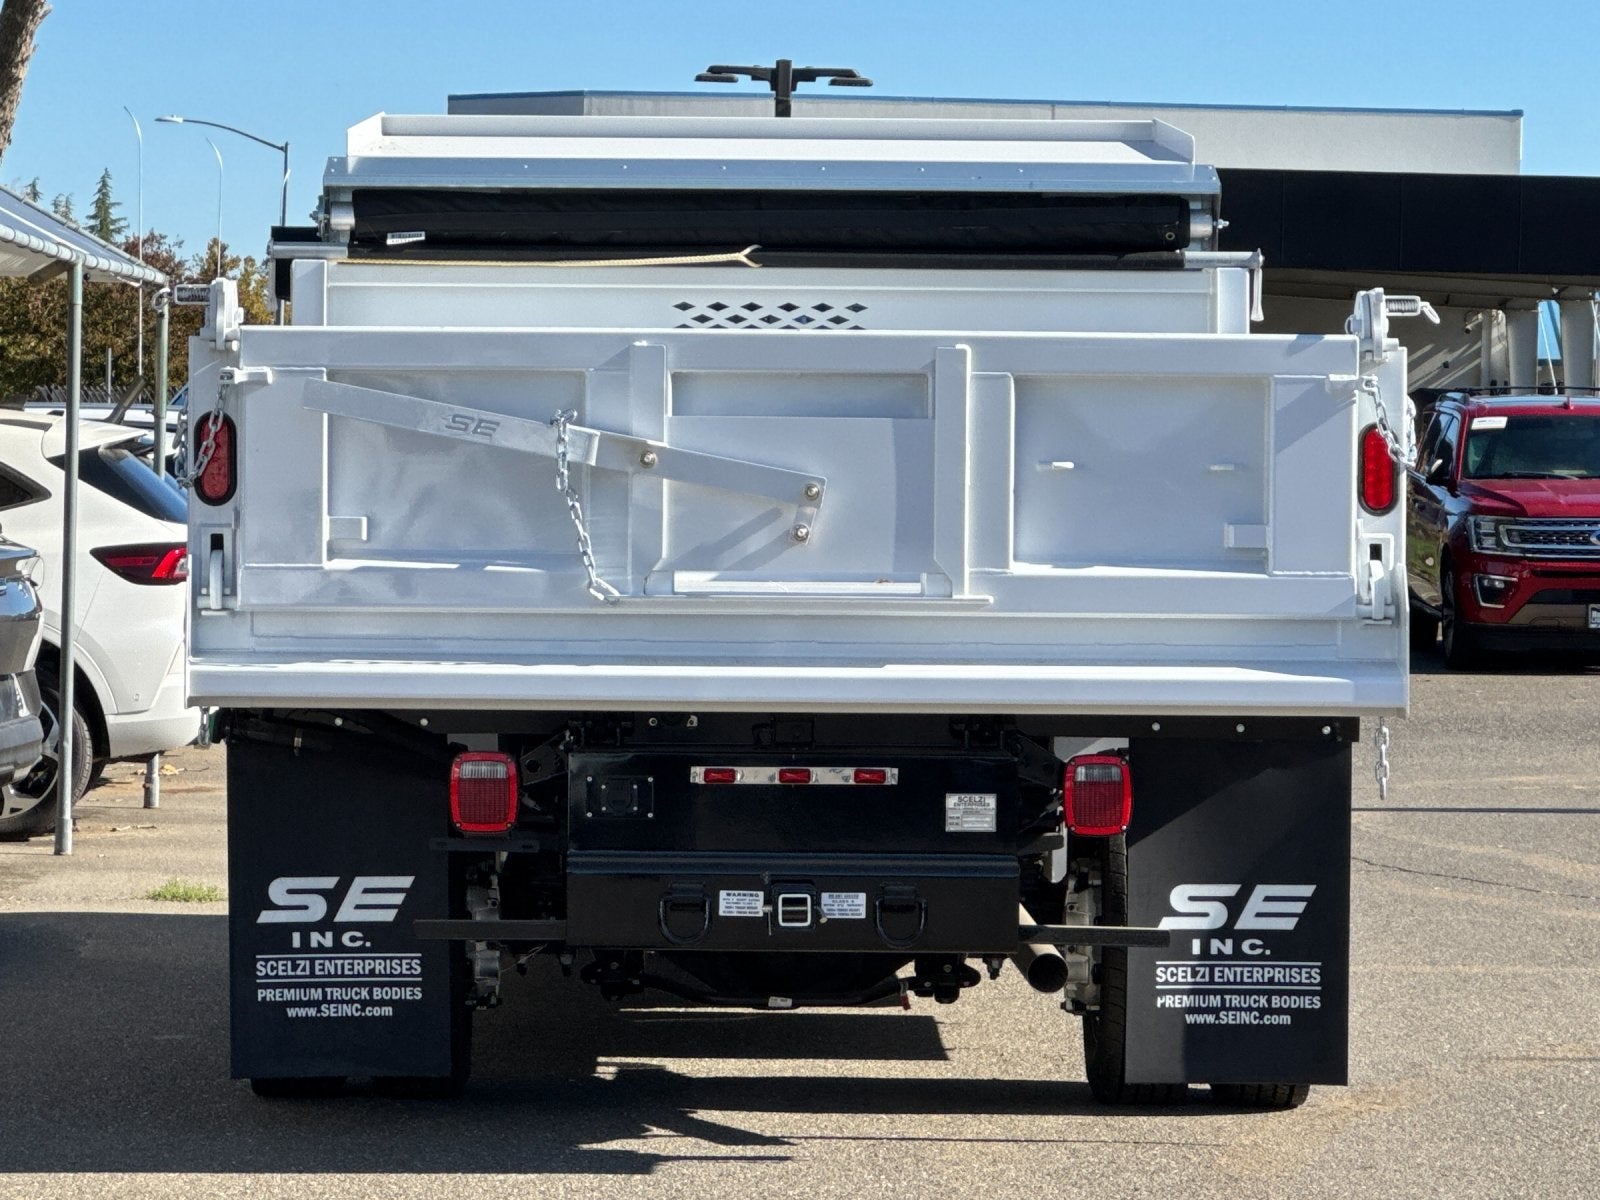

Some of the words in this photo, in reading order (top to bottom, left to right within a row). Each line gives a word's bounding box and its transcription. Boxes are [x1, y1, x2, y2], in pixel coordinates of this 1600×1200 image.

[445, 413, 500, 437] SE
[957, 795, 986, 803] SCELZI
[256, 875, 415, 924] SE
[1157, 883, 1317, 930] SE
[291, 931, 371, 948] INC.
[1191, 938, 1271, 955] INC.
[256, 960, 310, 976] SCELZI
[314, 959, 421, 976] ENTERPRISES
[1155, 966, 1210, 983] SCELZI
[1213, 966, 1321, 984] ENTERPRISES
[257, 987, 323, 1002] PREMIUM
[325, 986, 370, 1001] TRUCK
[372, 986, 422, 1000] BODIES
[1156, 994, 1221, 1008] PREMIUM
[1223, 994, 1269, 1008] TRUCK
[1271, 995, 1322, 1009] BODIES
[286, 1003, 393, 1018] www.SEINC.com
[1185, 1011, 1291, 1025] www.SEINC.com
